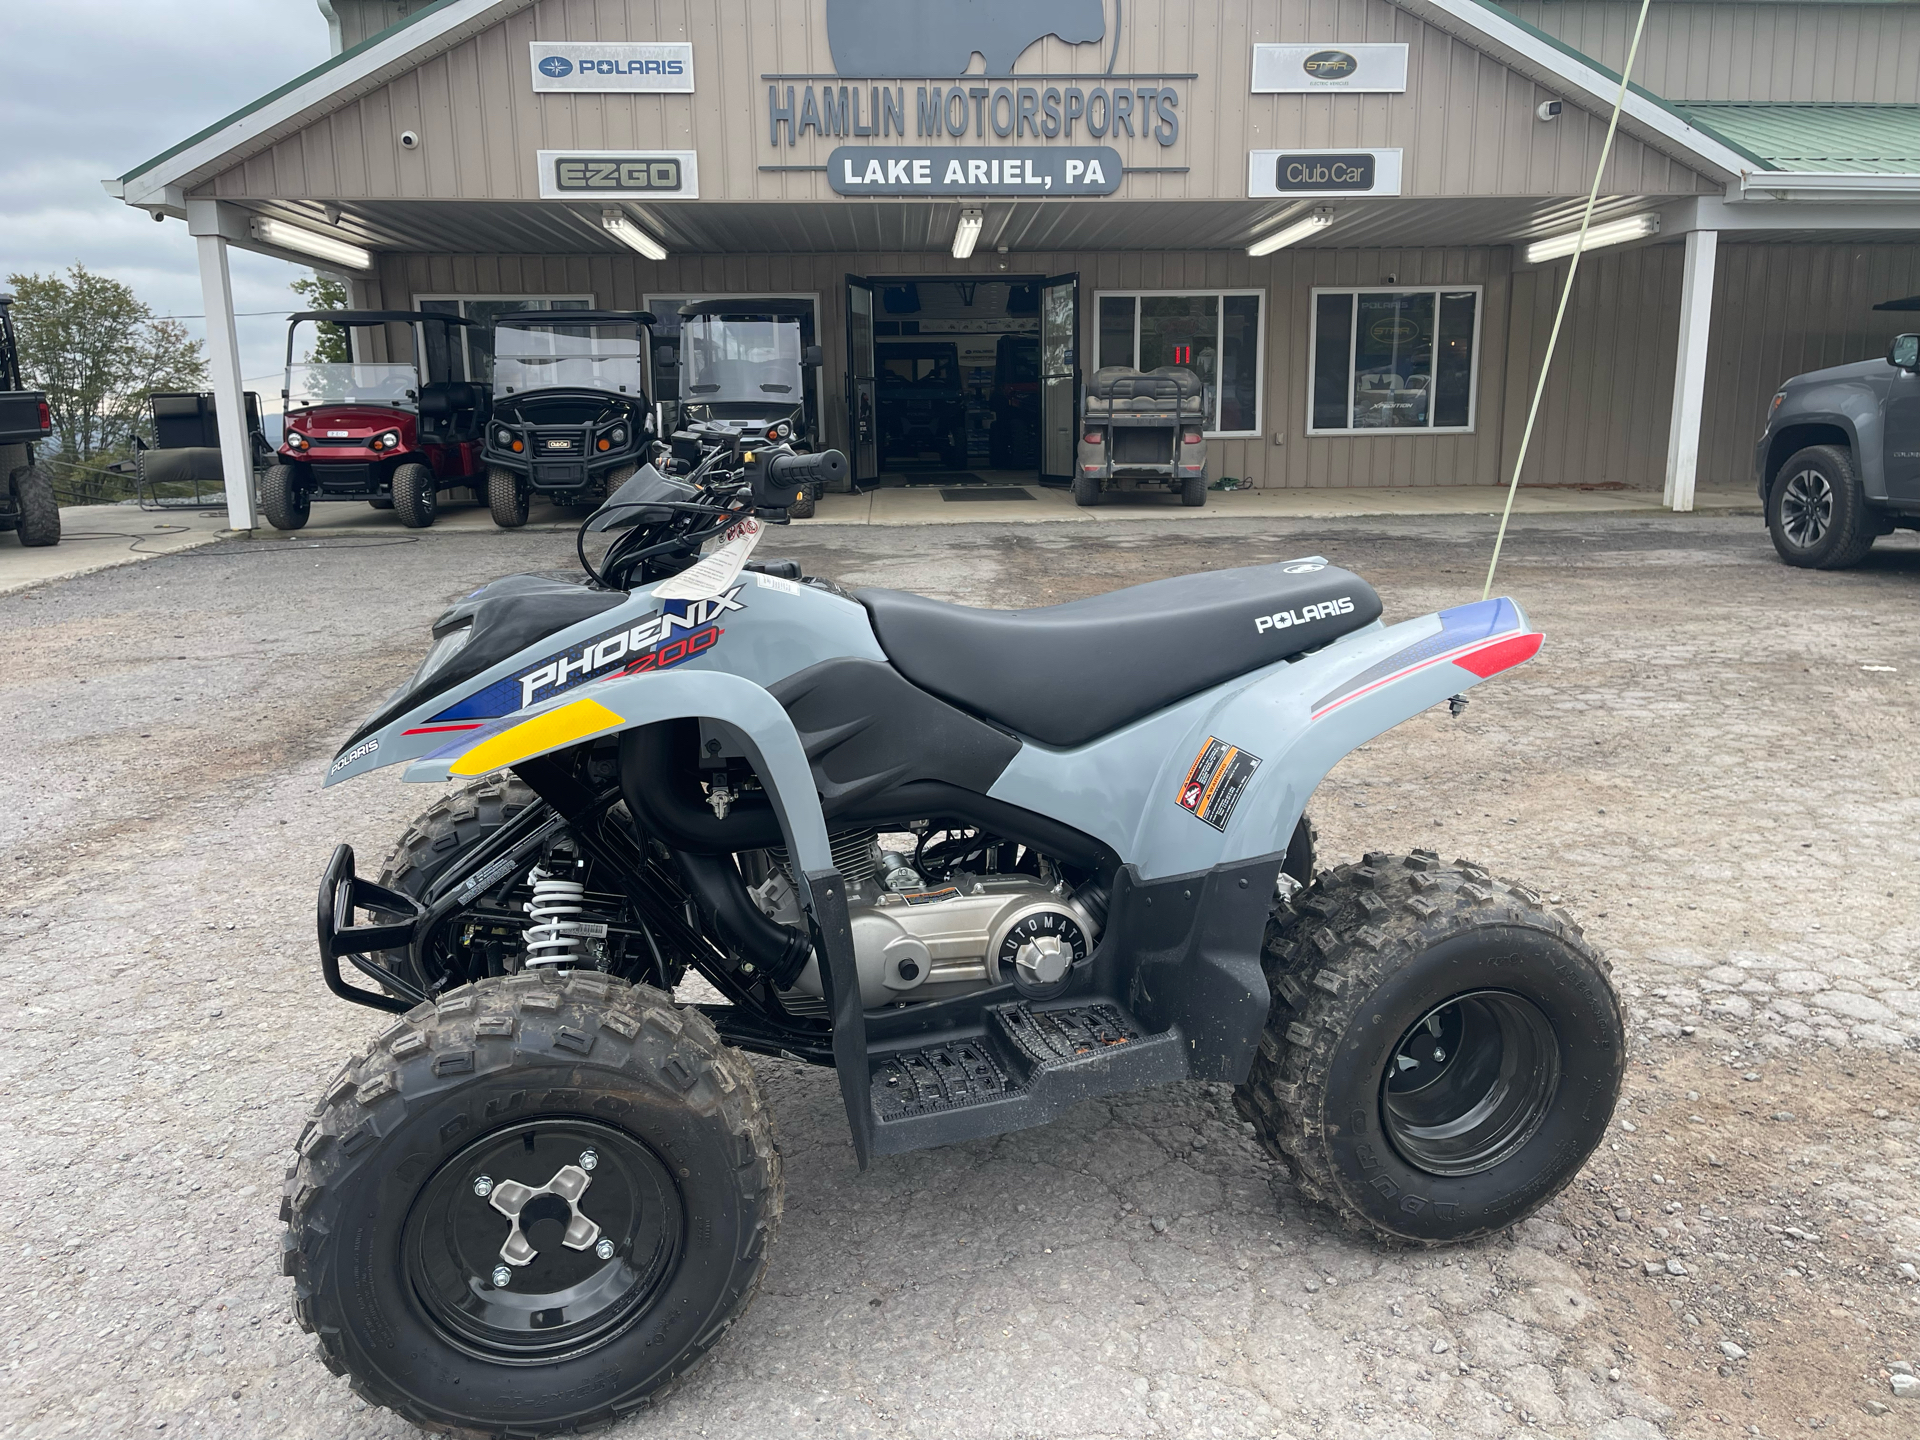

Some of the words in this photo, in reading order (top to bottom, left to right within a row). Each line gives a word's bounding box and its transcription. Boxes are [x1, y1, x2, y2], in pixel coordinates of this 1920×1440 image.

[579, 60, 684, 75] POLARIS
[1306, 61, 1347, 70] STAR
[769, 86, 904, 146] HAMLIN
[917, 86, 1179, 146] MOTORSPORTS
[559, 163, 678, 187] EZGO
[844, 159, 931, 184] LAKE
[943, 159, 1052, 190] ARIEL,
[1065, 159, 1106, 184] PA
[1287, 164, 1329, 183] Club
[1331, 163, 1364, 182] Car
[1373, 327, 1410, 335] STAR
[1255, 597, 1355, 634] POLARIS
[519, 583, 748, 708] PHOENIX
[622, 628, 725, 676] 200
[331, 739, 379, 777] POLARIS
[1209, 763, 1227, 792] WARNING
[1002, 916, 1084, 963] AUTOMATIC
[1351, 1107, 1431, 1218] DURO
